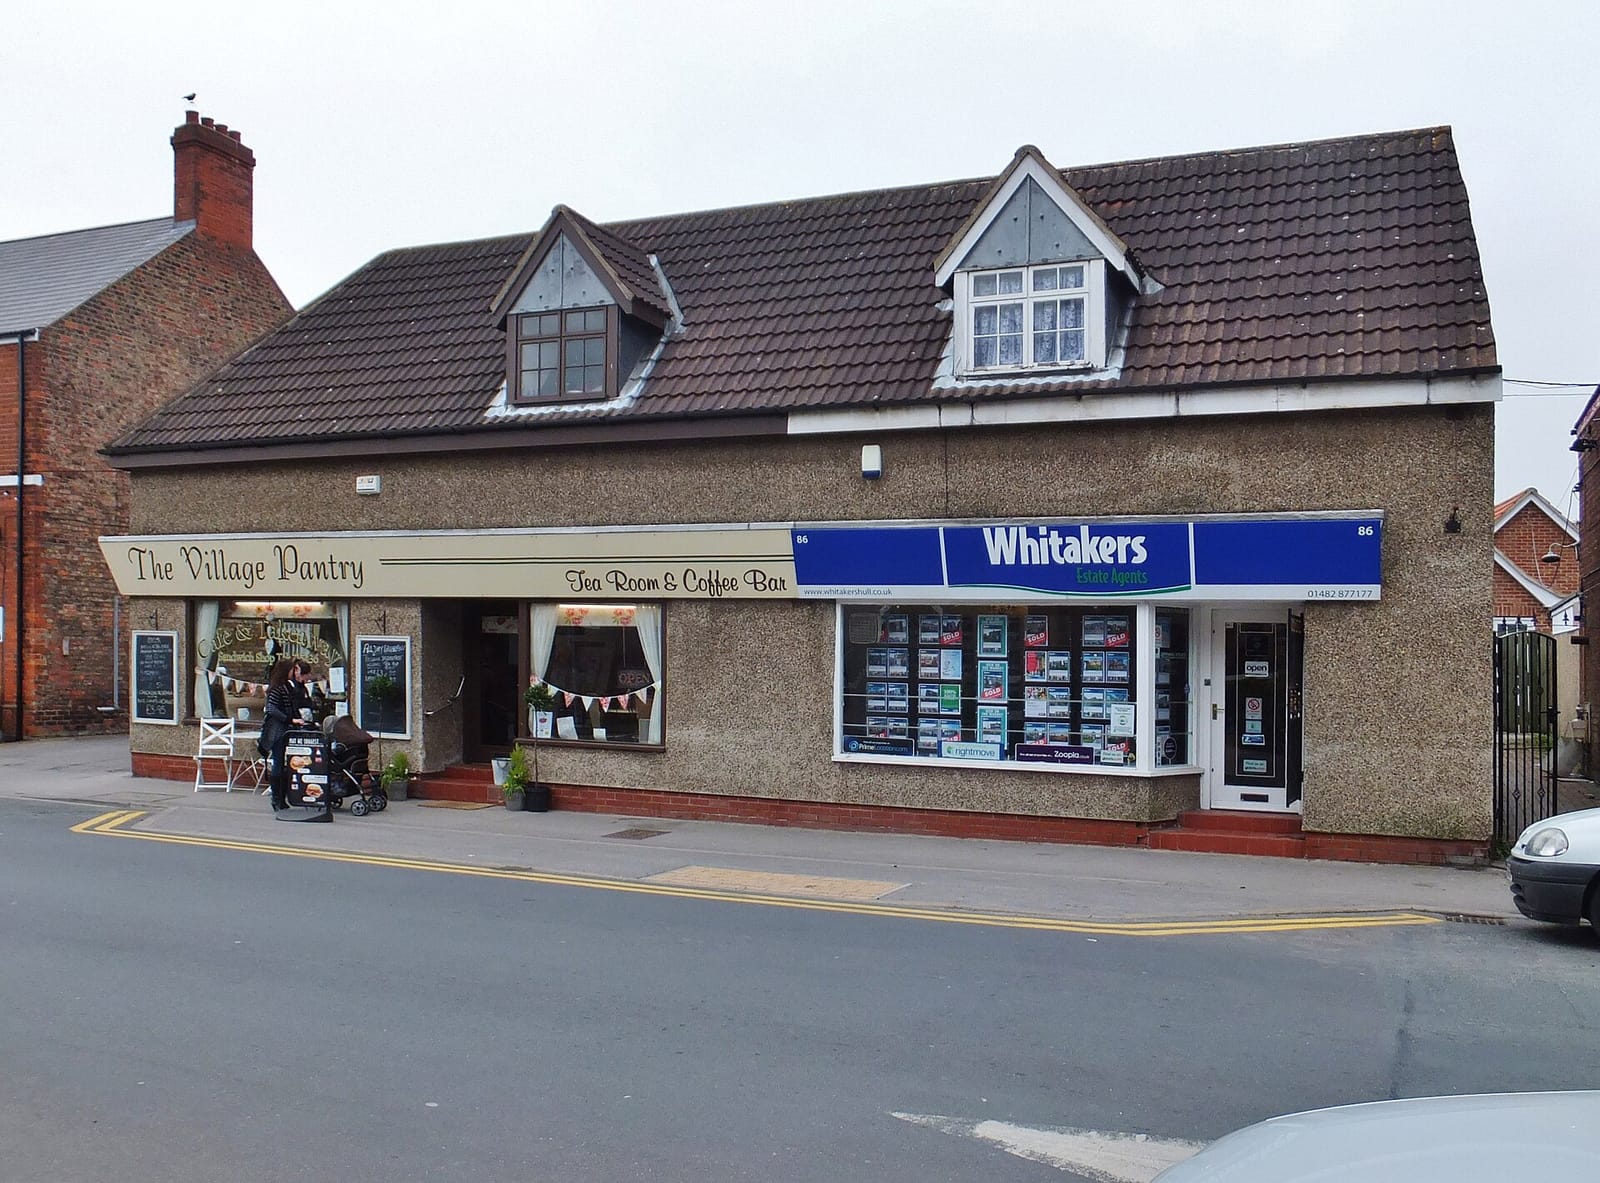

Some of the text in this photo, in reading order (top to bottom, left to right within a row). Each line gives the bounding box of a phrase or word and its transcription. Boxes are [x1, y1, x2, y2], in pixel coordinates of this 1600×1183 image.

[1358, 526, 1374, 536] 86
[796, 535, 809, 544] 86
[982, 525, 1148, 565] Whitakers
[128, 544, 364, 589] The Village Pantry
[1077, 567, 1148, 587] Estate Agents
[565, 568, 788, 597] Tea Room & Coffee Bar
[803, 588, 893, 596] www.whitakershull.co.uk
[1307, 590, 1373, 598] 01482 877177
[942, 631, 960, 641] SOLD
[1027, 632, 1045, 643] SOLD
[1107, 633, 1126, 643] SOLD
[1246, 665, 1267, 673] open
[984, 687, 1001, 697] SOLD
[955, 747, 995, 758] rightmove
